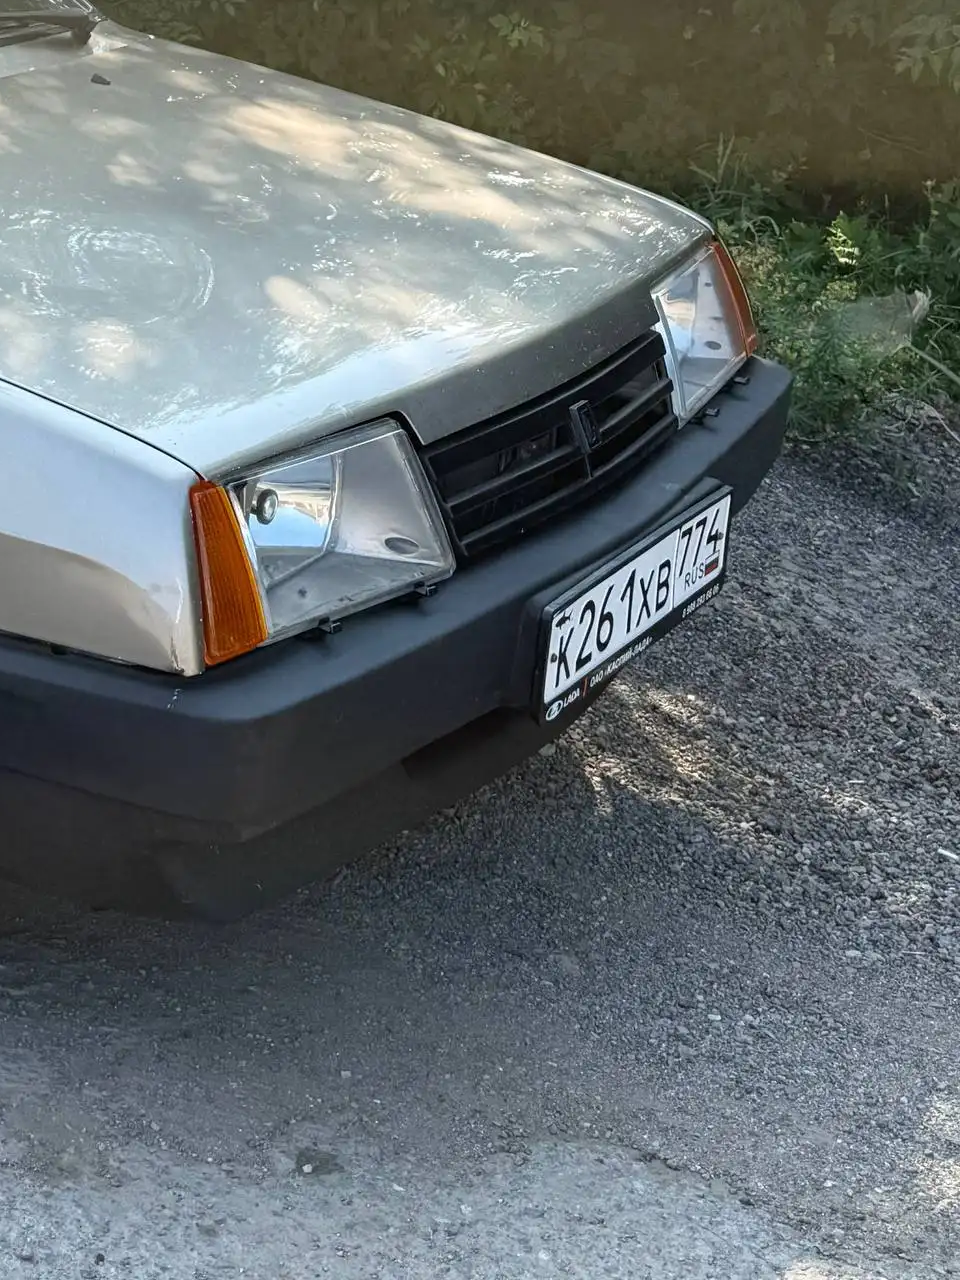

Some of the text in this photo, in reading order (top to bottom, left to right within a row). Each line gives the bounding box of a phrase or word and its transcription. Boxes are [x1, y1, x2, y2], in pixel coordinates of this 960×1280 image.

[678, 508, 721, 577] 774
[684, 563, 705, 591] RUS
[563, 687, 580, 708] LADA
